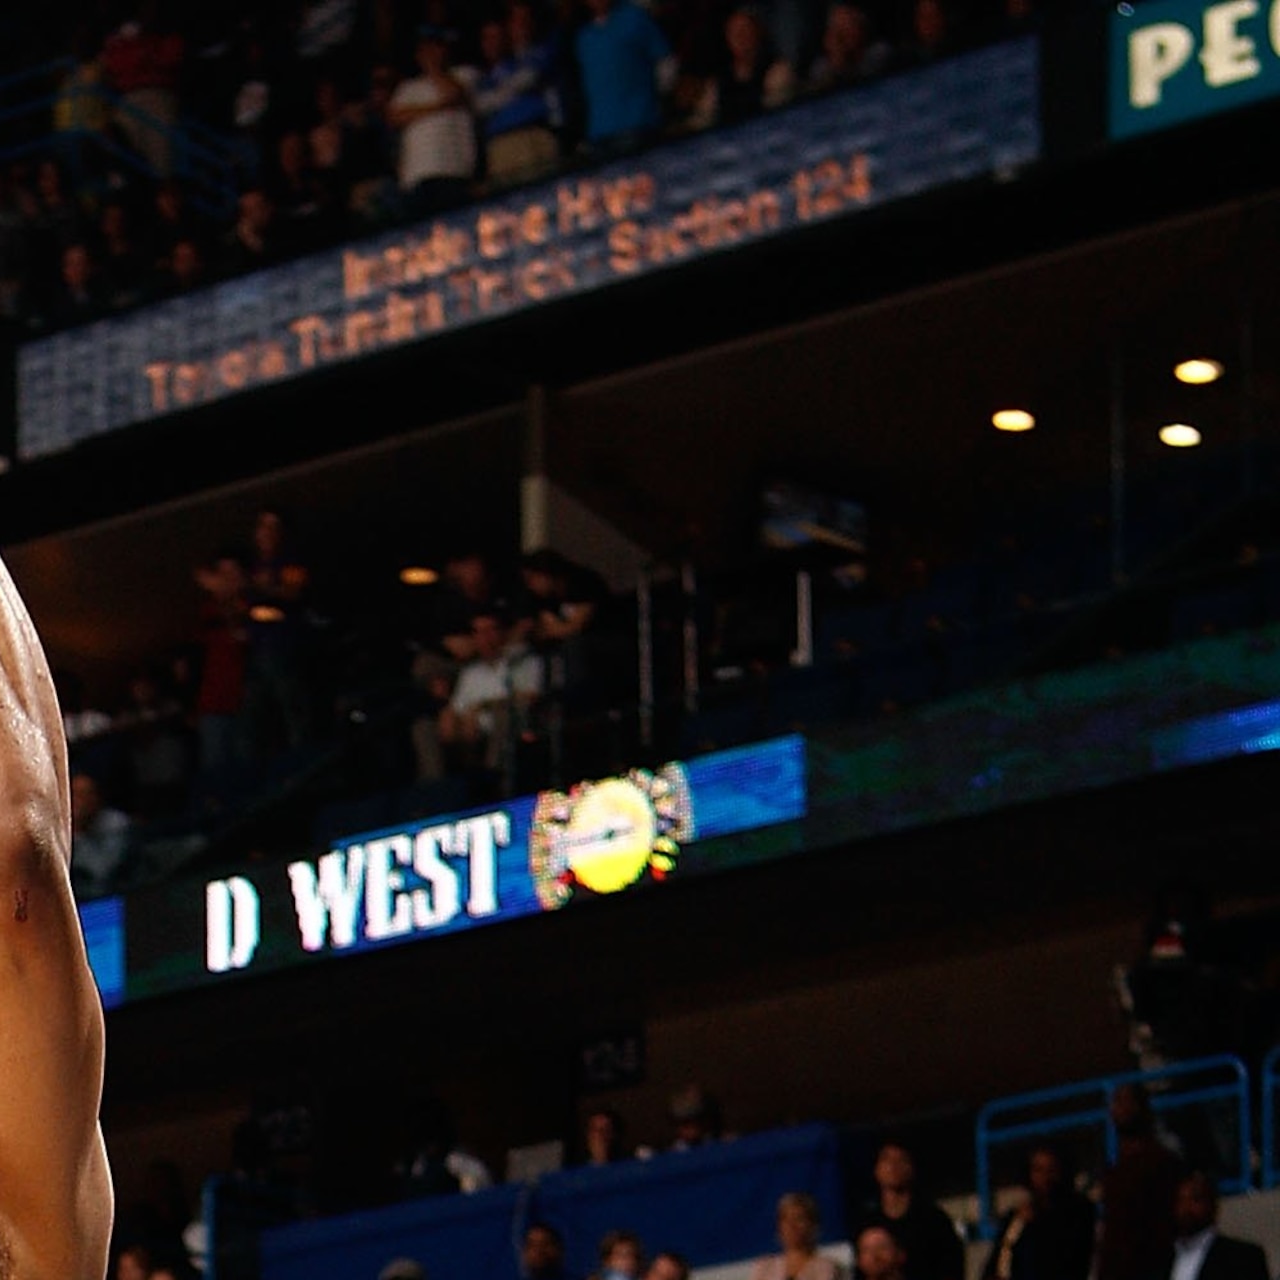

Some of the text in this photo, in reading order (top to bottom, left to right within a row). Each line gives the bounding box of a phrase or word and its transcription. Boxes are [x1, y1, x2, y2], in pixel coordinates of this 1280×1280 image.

[1128, 0, 1280, 109] PE
[206, 811, 511, 972] D WEST
